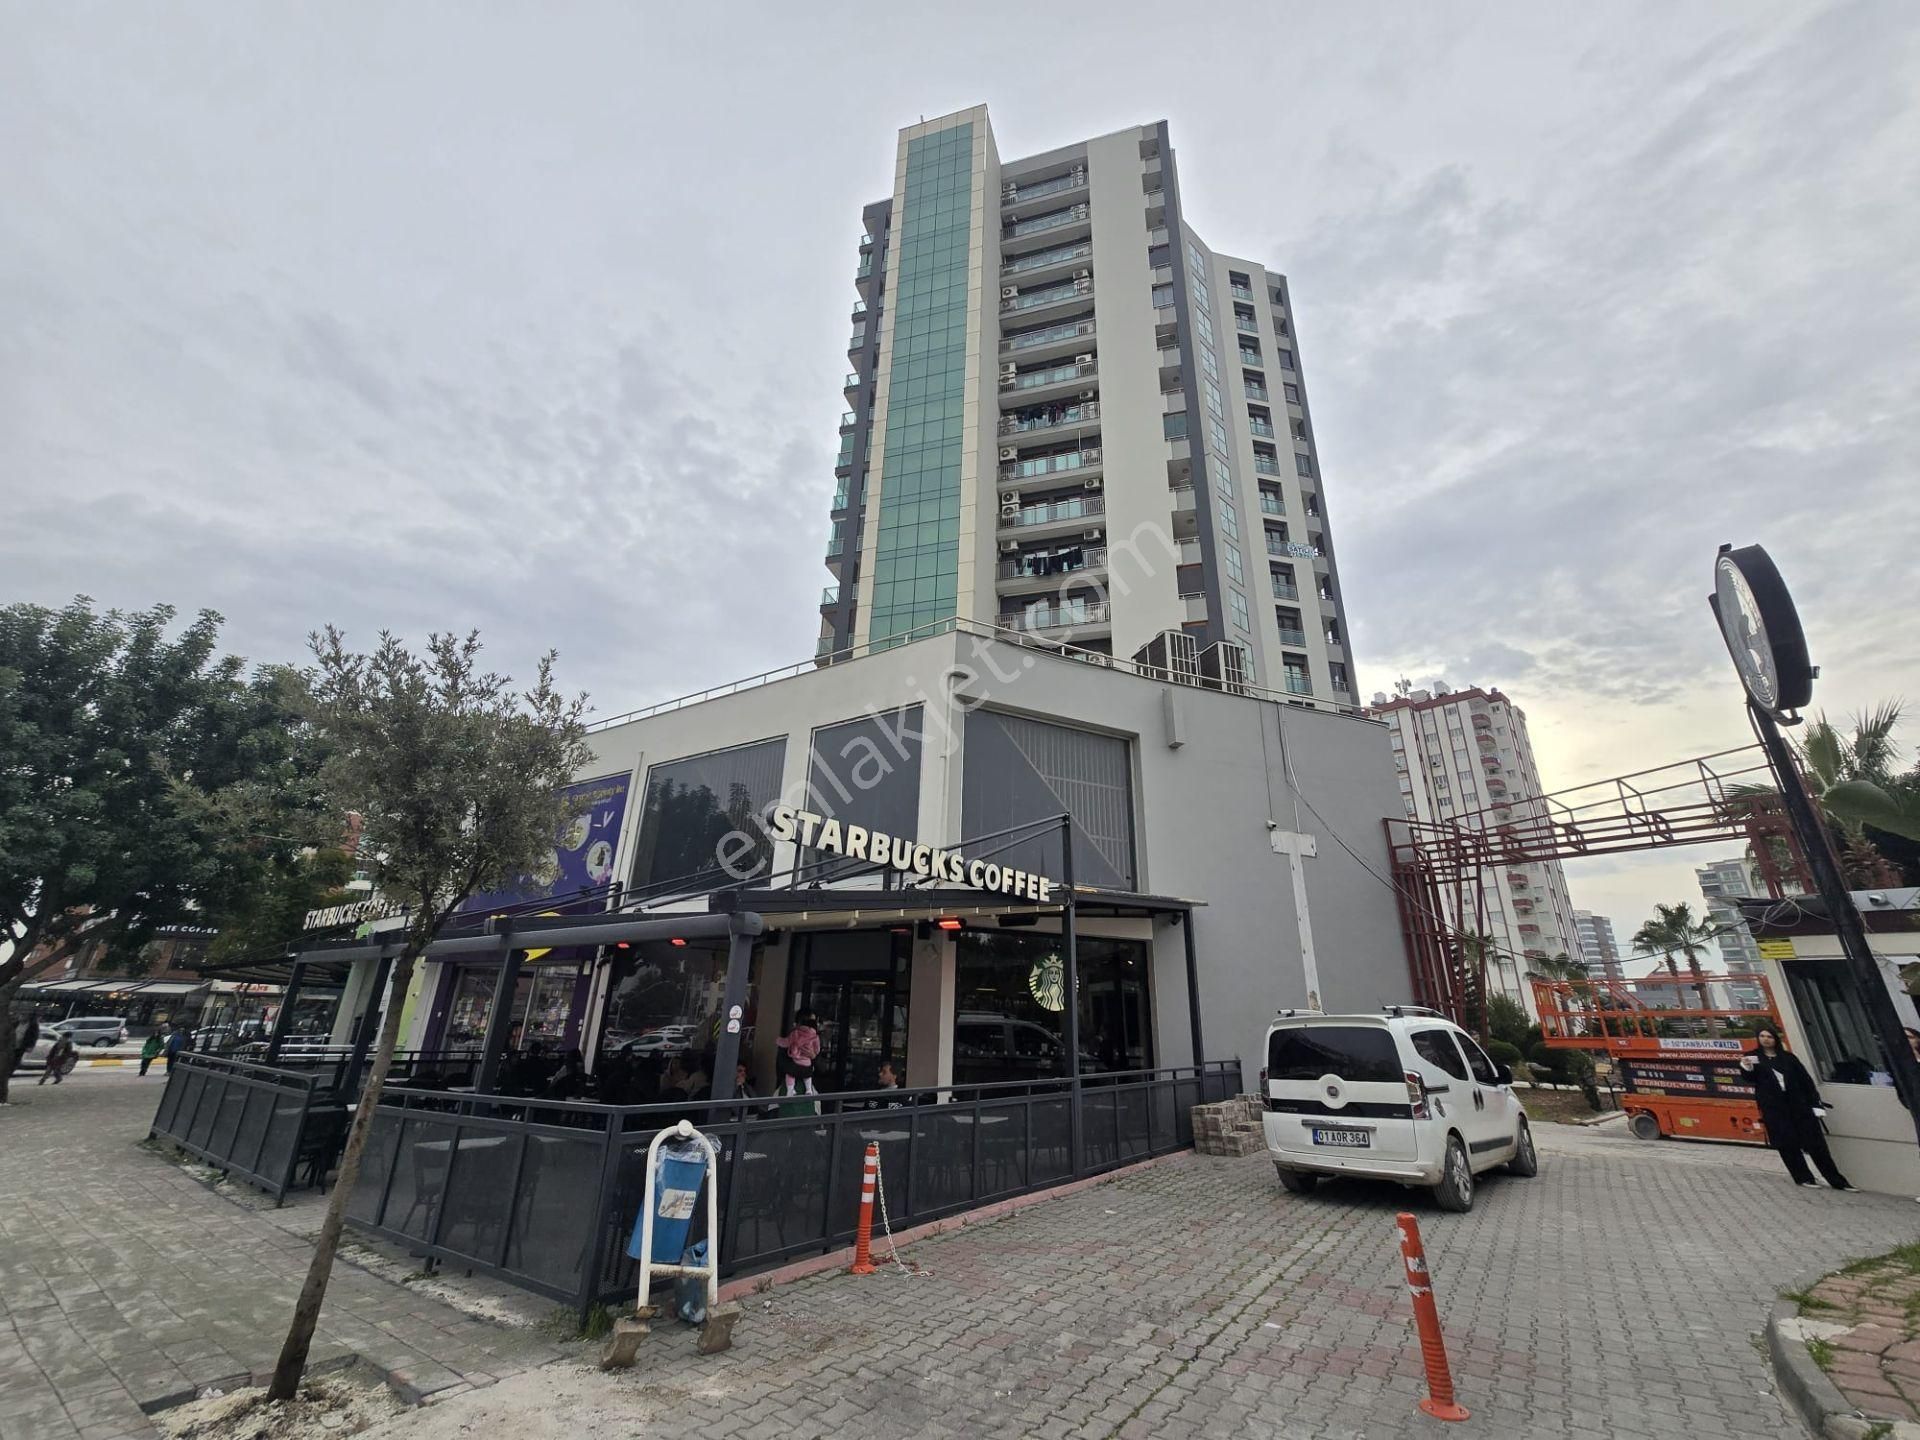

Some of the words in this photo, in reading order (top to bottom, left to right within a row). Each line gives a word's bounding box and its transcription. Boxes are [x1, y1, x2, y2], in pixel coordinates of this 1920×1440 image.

[771, 805, 964, 882] STARBUCKS
[970, 859, 1050, 902] COFFEE
[303, 901, 364, 930] STARBUCKS
[1318, 1131, 1329, 1142] 01
[1349, 1132, 1367, 1144] 364
